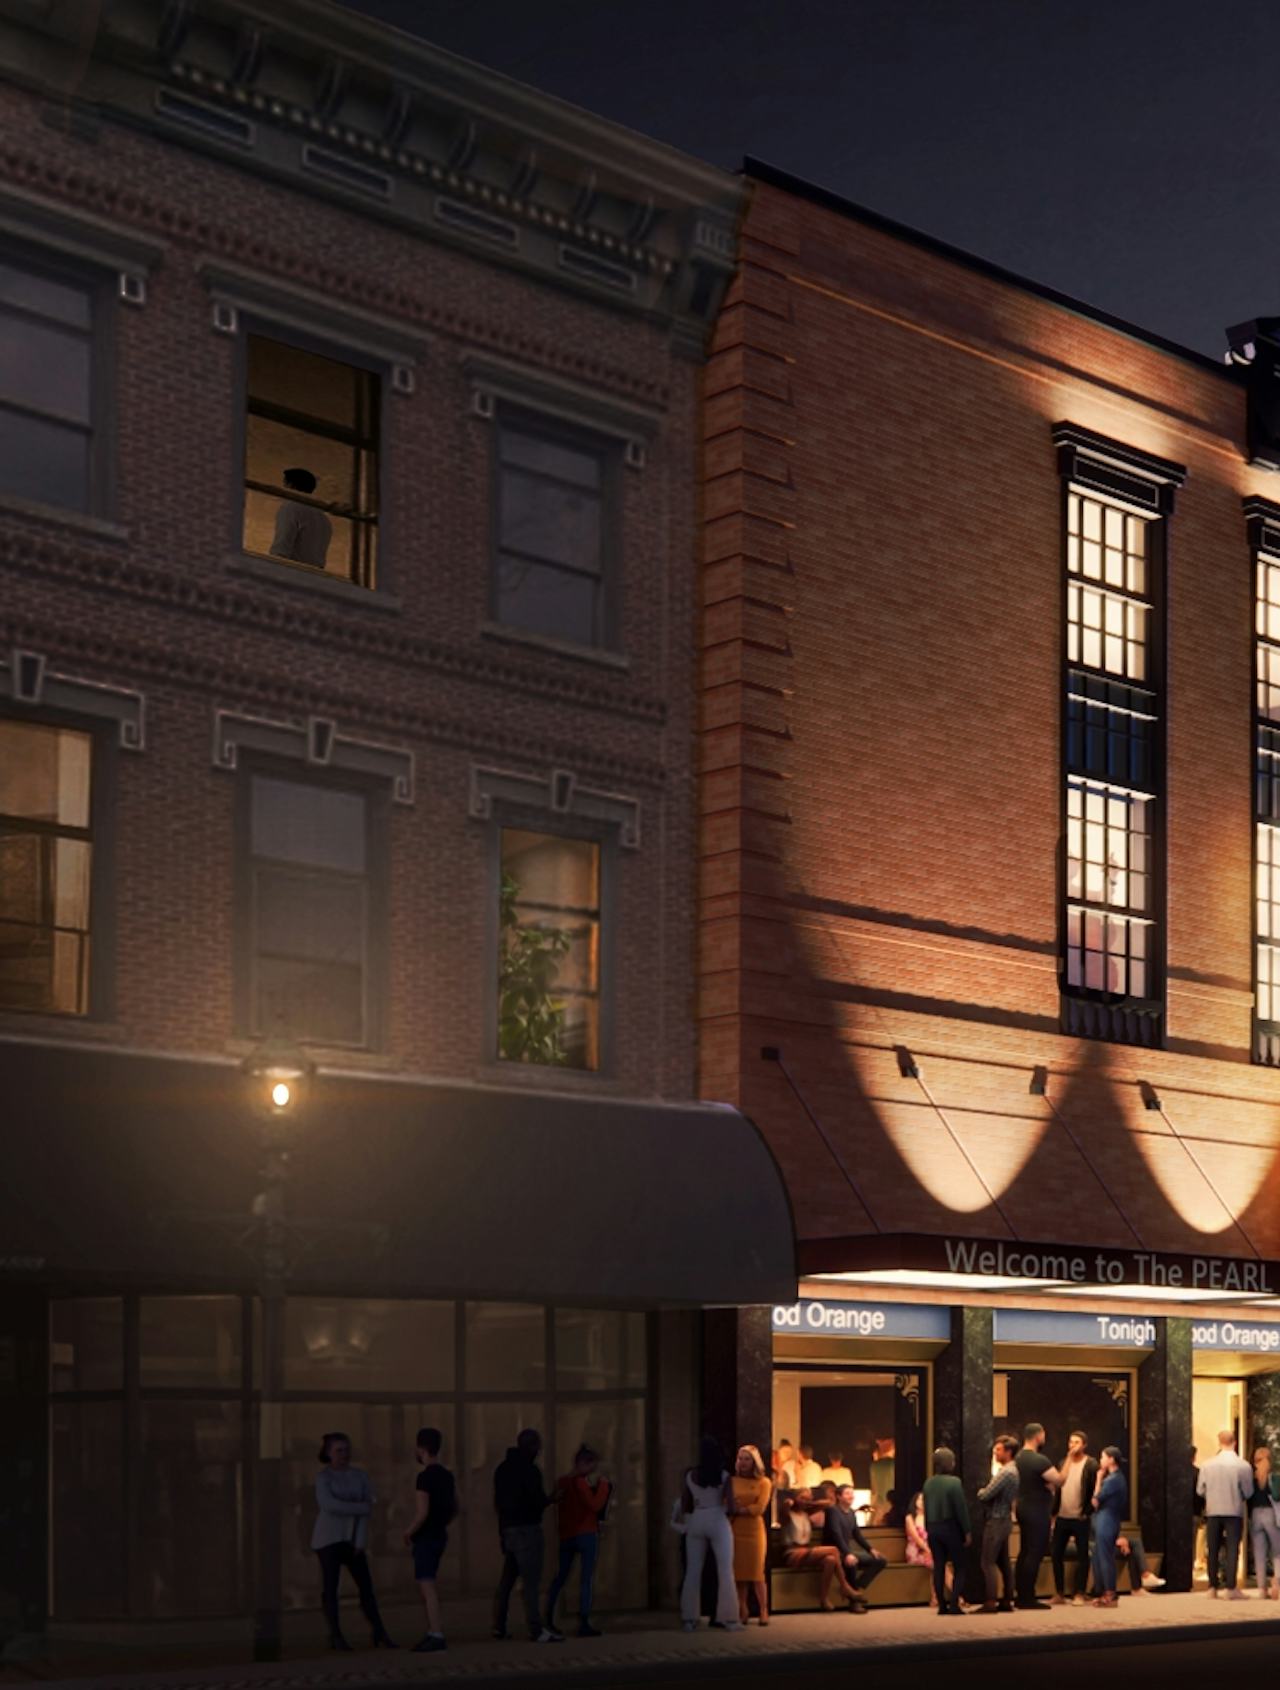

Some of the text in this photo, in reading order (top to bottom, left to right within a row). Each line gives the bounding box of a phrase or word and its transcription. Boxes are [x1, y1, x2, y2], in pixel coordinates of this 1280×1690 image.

[945, 1240, 1273, 1293] Welcome to The PEARL
[807, 1302, 885, 1335] Orange
[1097, 1317, 1156, 1346] Tonigh
[1221, 1323, 1279, 1350] Orange
